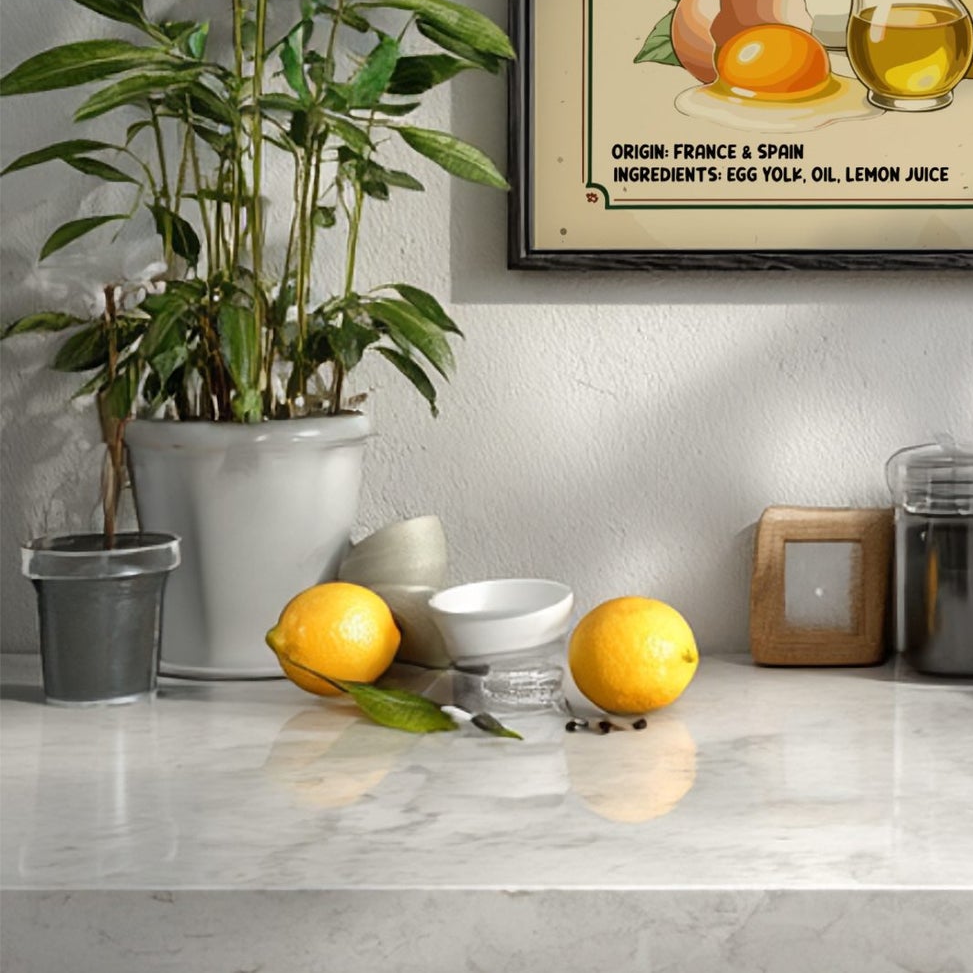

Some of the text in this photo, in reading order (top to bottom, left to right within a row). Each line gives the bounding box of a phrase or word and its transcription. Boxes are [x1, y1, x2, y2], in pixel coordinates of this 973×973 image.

[612, 144, 804, 159] ORIGIN: FRANCE & SPAIN
[613, 166, 949, 183] INGREDIENTS: EGG YOLK, OIL, LEMON JUICE
